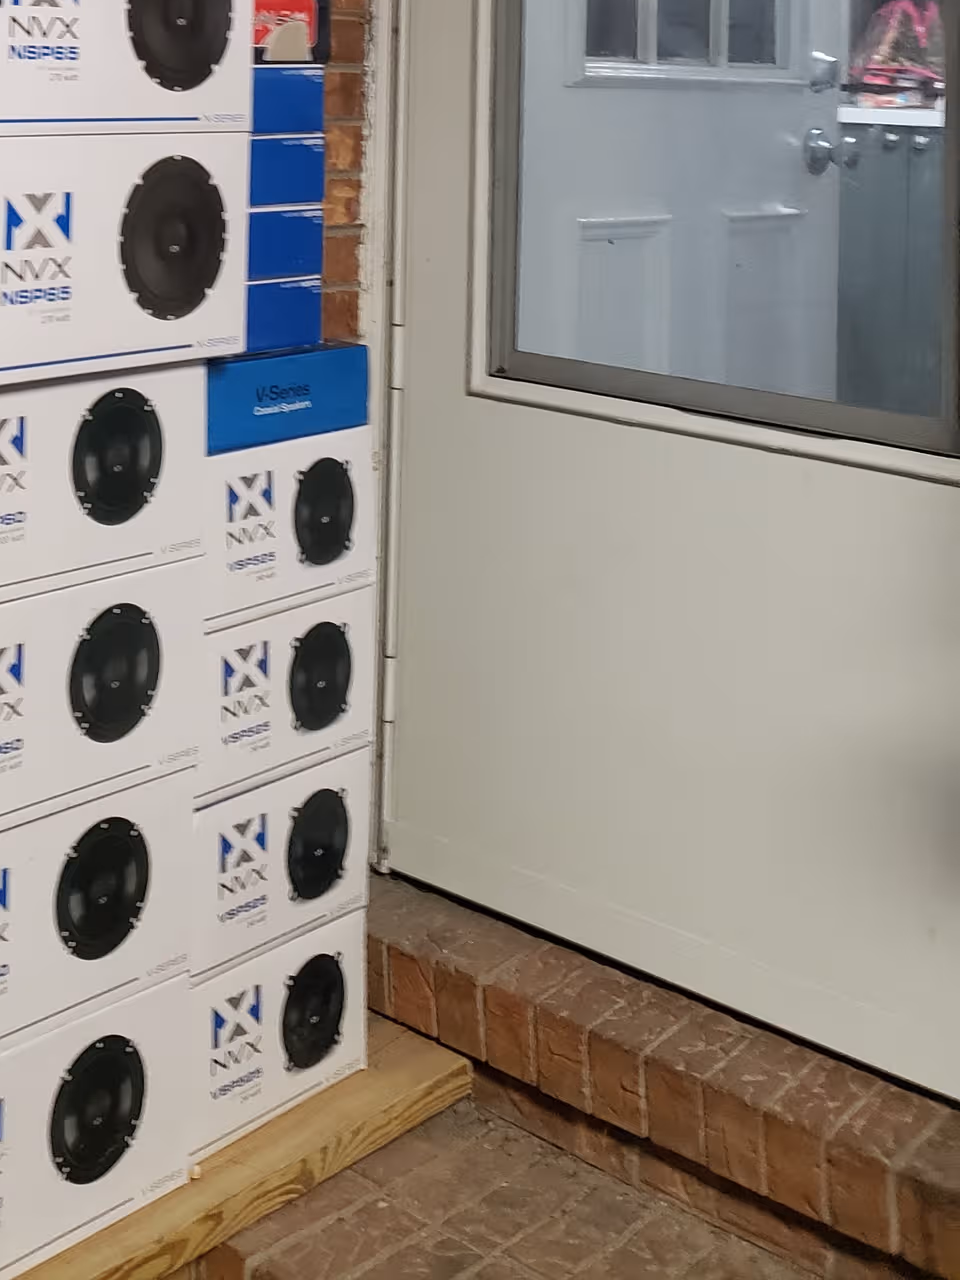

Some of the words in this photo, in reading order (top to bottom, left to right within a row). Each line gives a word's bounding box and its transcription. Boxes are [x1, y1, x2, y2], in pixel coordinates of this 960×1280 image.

[7, 14, 81, 40] NVX
[7, 44, 81, 61] NSP65
[0, 255, 72, 285] NVX
[0, 285, 72, 307] NSP65
[256, 383, 311, 403] V-Series
[226, 520, 277, 550] NVX
[221, 690, 271, 723] NVX
[217, 863, 268, 901] NVX
[209, 1034, 263, 1078] NVX
